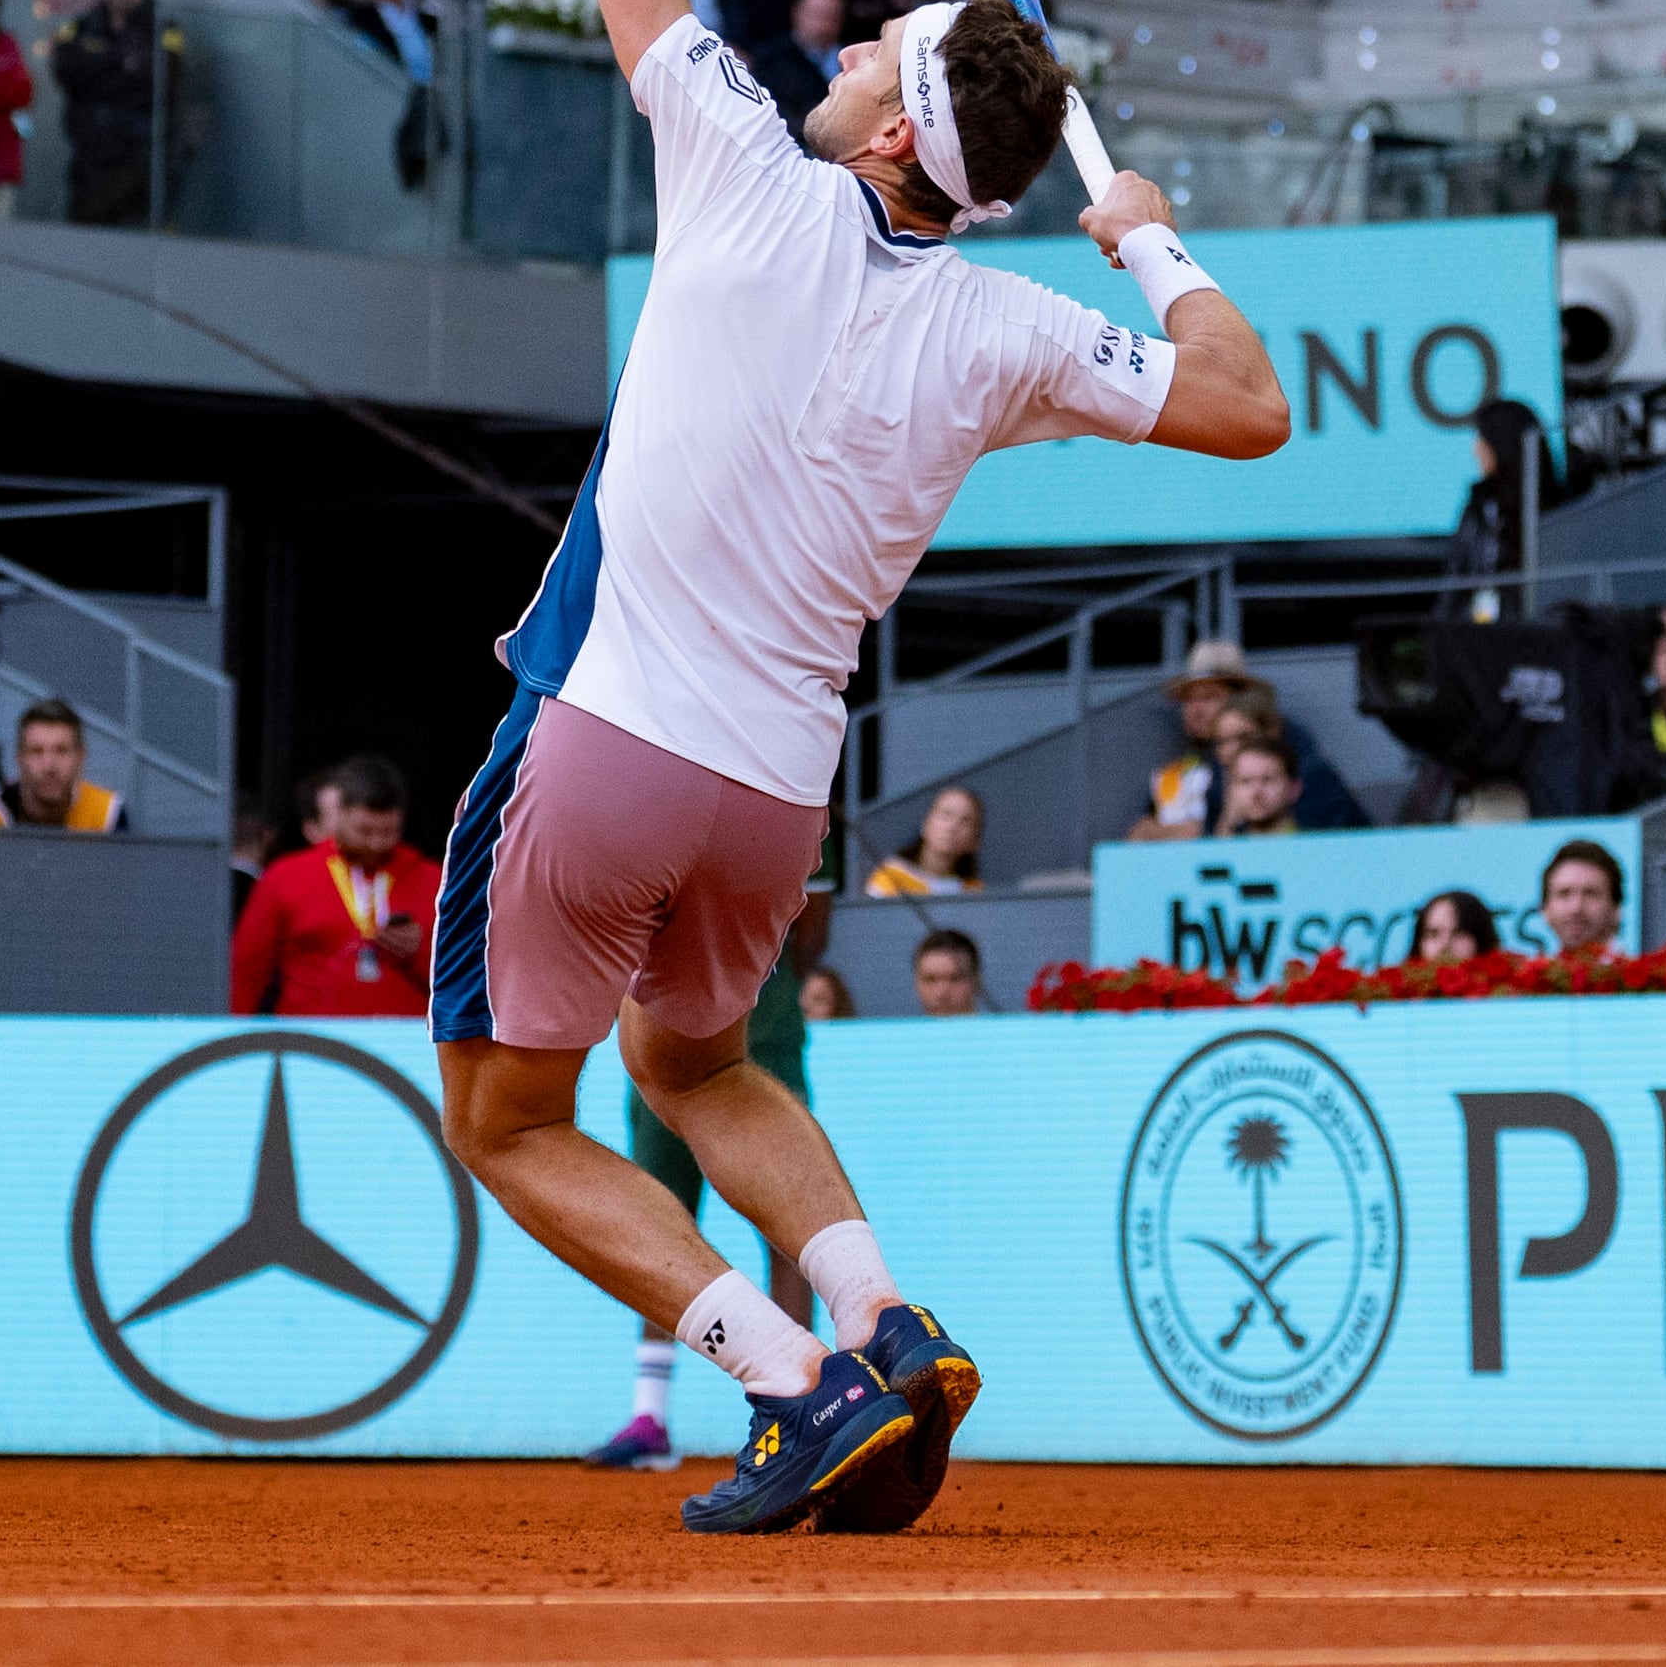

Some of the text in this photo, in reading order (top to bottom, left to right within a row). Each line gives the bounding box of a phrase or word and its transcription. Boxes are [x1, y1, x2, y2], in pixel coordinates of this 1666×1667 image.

[686, 37, 722, 66] YONEX
[917, 36, 935, 129] Samsonite
[1298, 324, 1501, 436] NO
[812, 1397, 843, 1427] Casper
